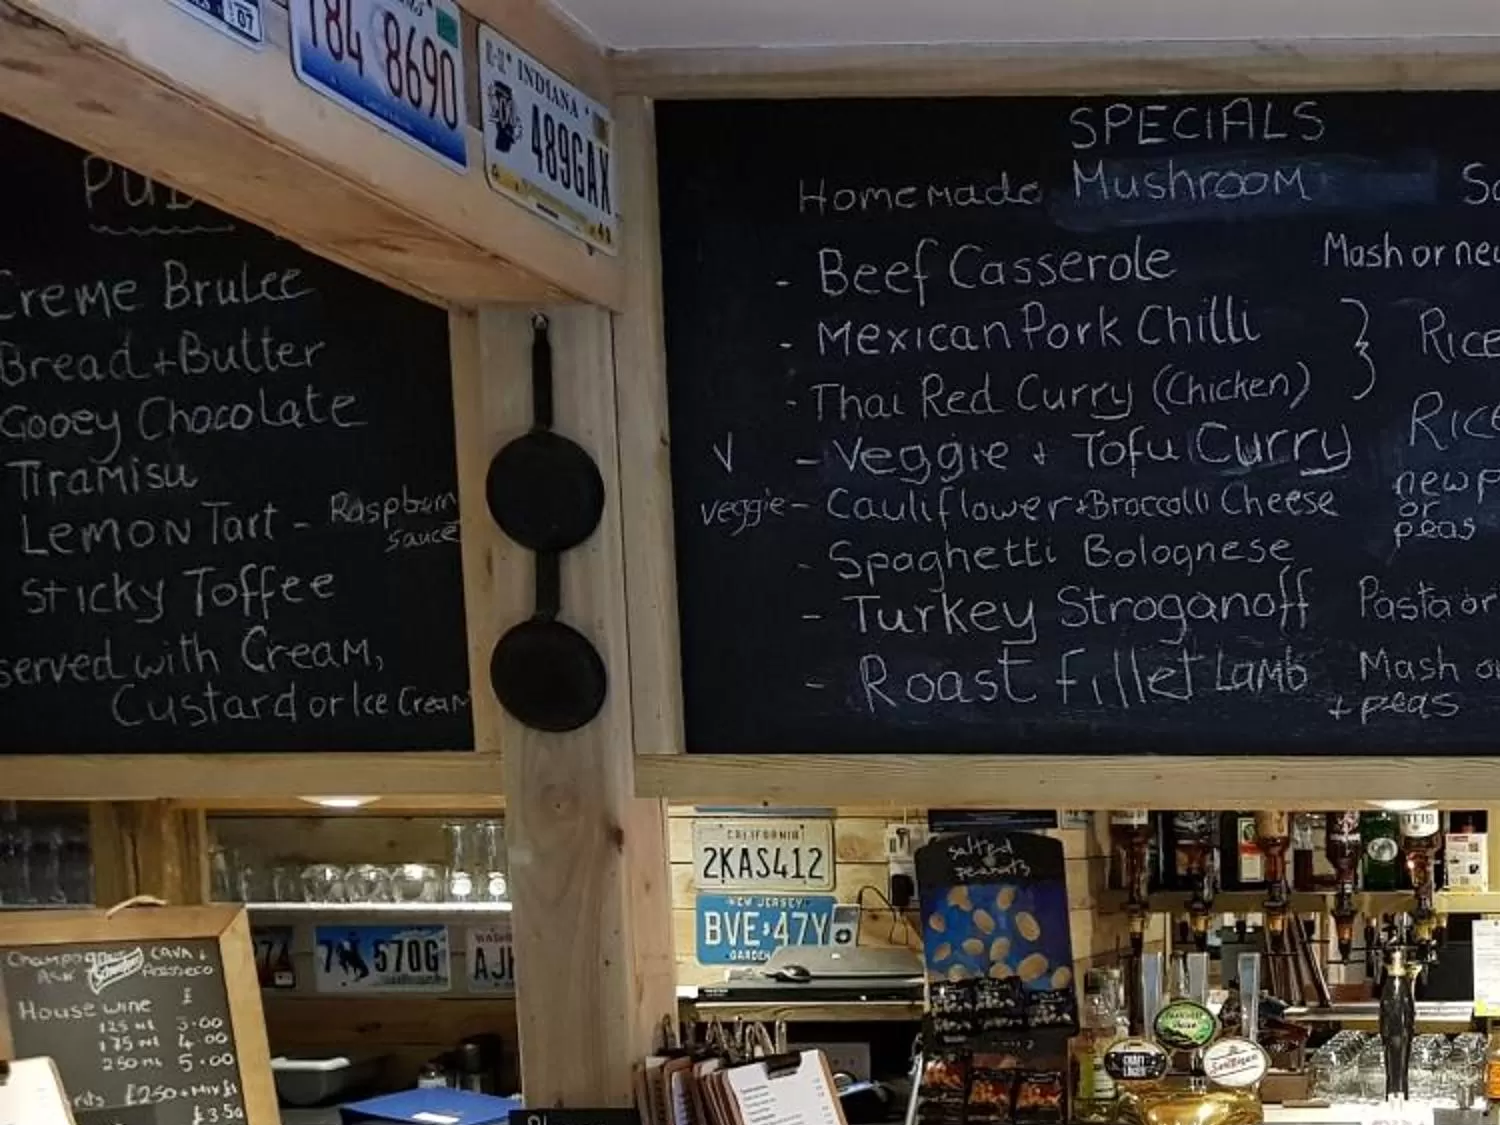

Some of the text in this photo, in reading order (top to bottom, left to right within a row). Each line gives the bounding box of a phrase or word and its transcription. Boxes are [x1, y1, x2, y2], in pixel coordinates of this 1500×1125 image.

[382, 11, 459, 131] 8690
[516, 57, 580, 119] INDIANA
[1069, 97, 1326, 150] SPECIALS
[530, 103, 614, 217] 489GAX
[818, 237, 939, 308] Beef
[949, 235, 1179, 290] Casserole
[1324, 231, 1404, 269] Mash
[1412, 243, 1442, 268] or
[818, 319, 1011, 357] Mexican
[1021, 300, 1122, 351] Pork
[1138, 294, 1261, 347] Chilli
[0, 330, 149, 388] Bread
[138, 383, 369, 441] Chocolate
[810, 382, 901, 421] Thai
[920, 371, 1007, 420] Red
[1016, 373, 1134, 421] Curry
[832, 435, 1010, 485] Veggie
[1070, 424, 1181, 479] Tofu
[1196, 422, 1352, 477] Curry
[201, 501, 279, 546] Tart
[826, 486, 1072, 531] Cauliflower
[1219, 481, 1341, 518] Cheese
[1393, 518, 1477, 551] peas
[182, 561, 336, 620] Toffee
[829, 537, 1058, 593] Spaghetti
[1083, 532, 1296, 577] Bolognese
[842, 594, 1037, 645] Turkey
[1057, 565, 1314, 646] Stroganoff
[1359, 574, 1454, 622] Pasta
[1460, 594, 1492, 620] or
[134, 632, 221, 680] with
[859, 645, 1038, 714] Roast
[1359, 646, 1461, 682] Mash
[111, 682, 298, 728] Custard
[308, 696, 341, 719] or
[1360, 690, 1461, 725] peas
[702, 846, 824, 881] 2KAS412
[19, 998, 152, 1021] House wine
